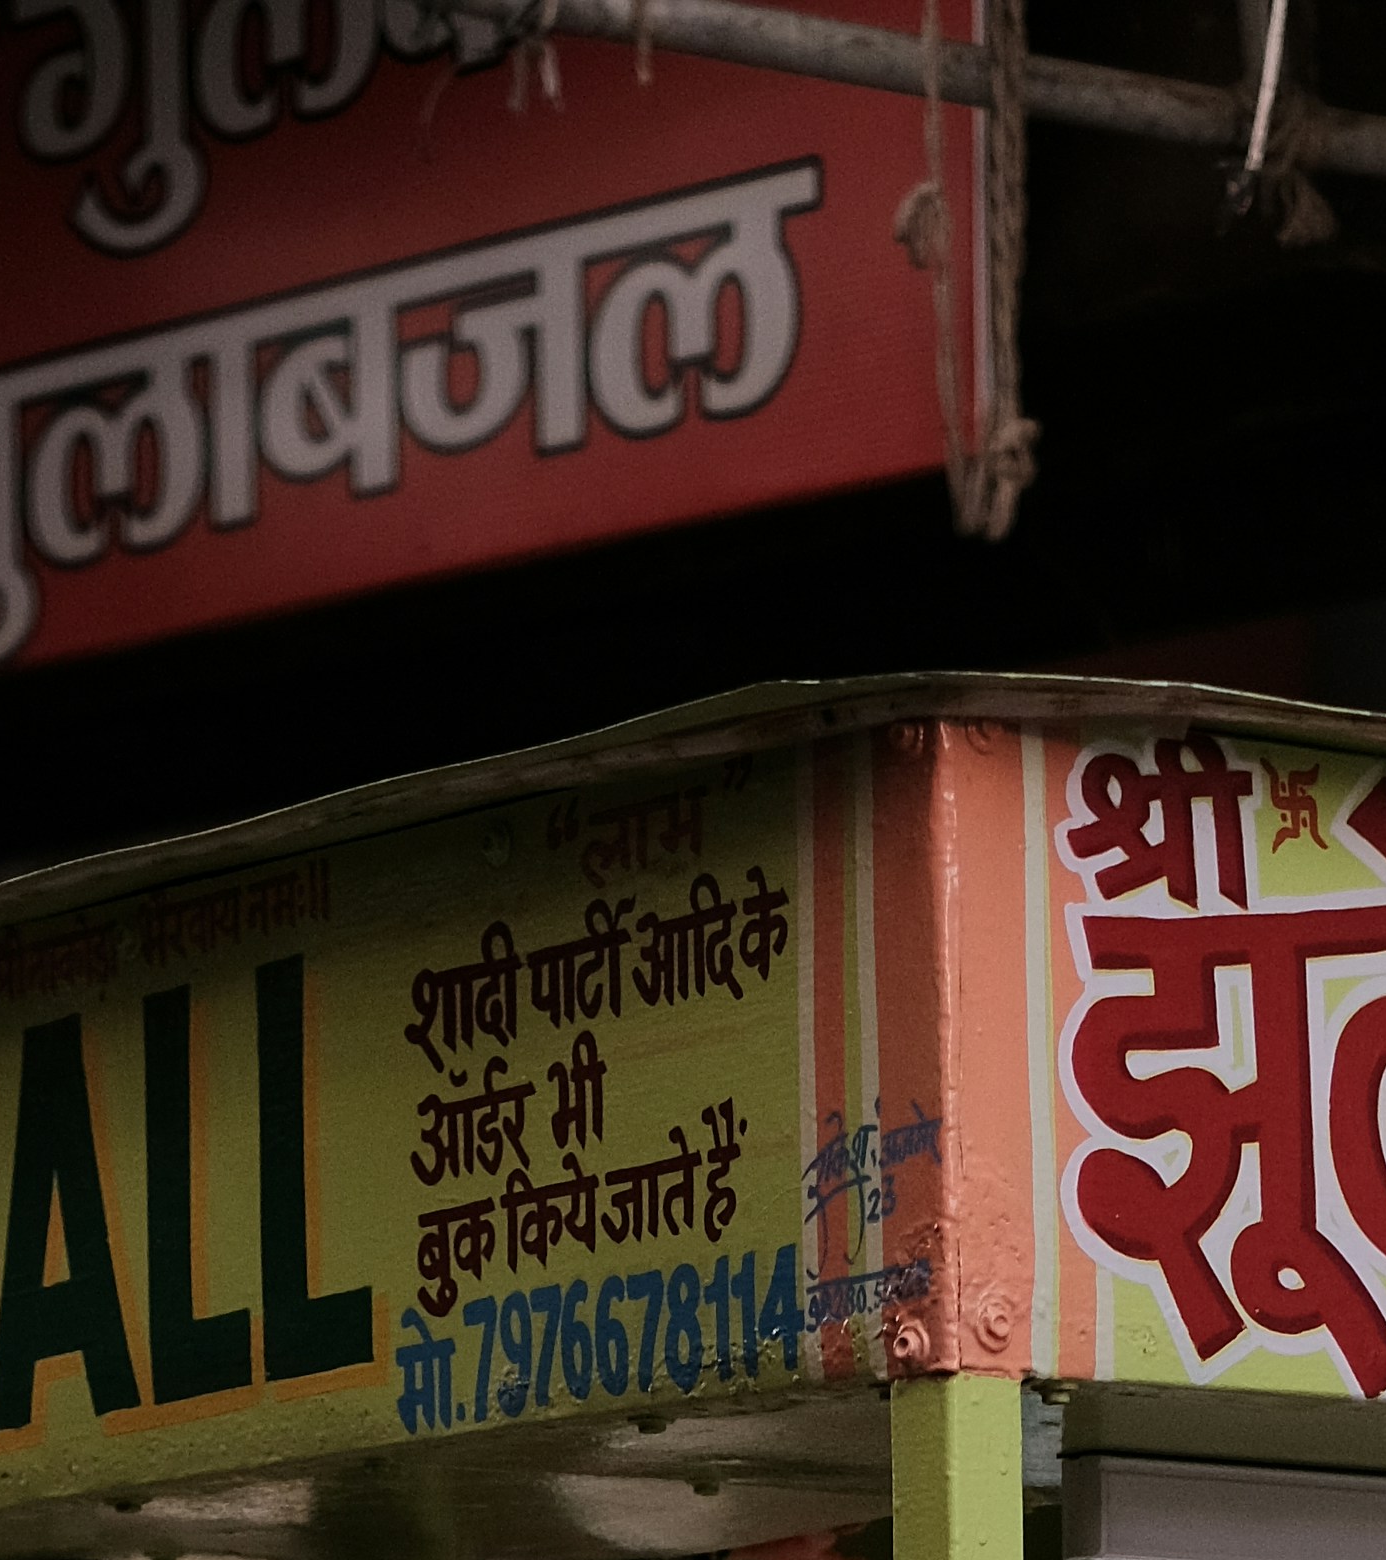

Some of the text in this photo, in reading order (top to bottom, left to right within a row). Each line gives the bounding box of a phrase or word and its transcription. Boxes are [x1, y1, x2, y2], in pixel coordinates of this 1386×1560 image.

[1068, 727, 1253, 908] श्री
[405, 865, 789, 1072] शादी पार्टी आदि के
[548, 1029, 606, 1149] भी
[418, 1196, 496, 1317] बुक
[501, 1153, 598, 1274] किये
[602, 1127, 701, 1245] जाते
